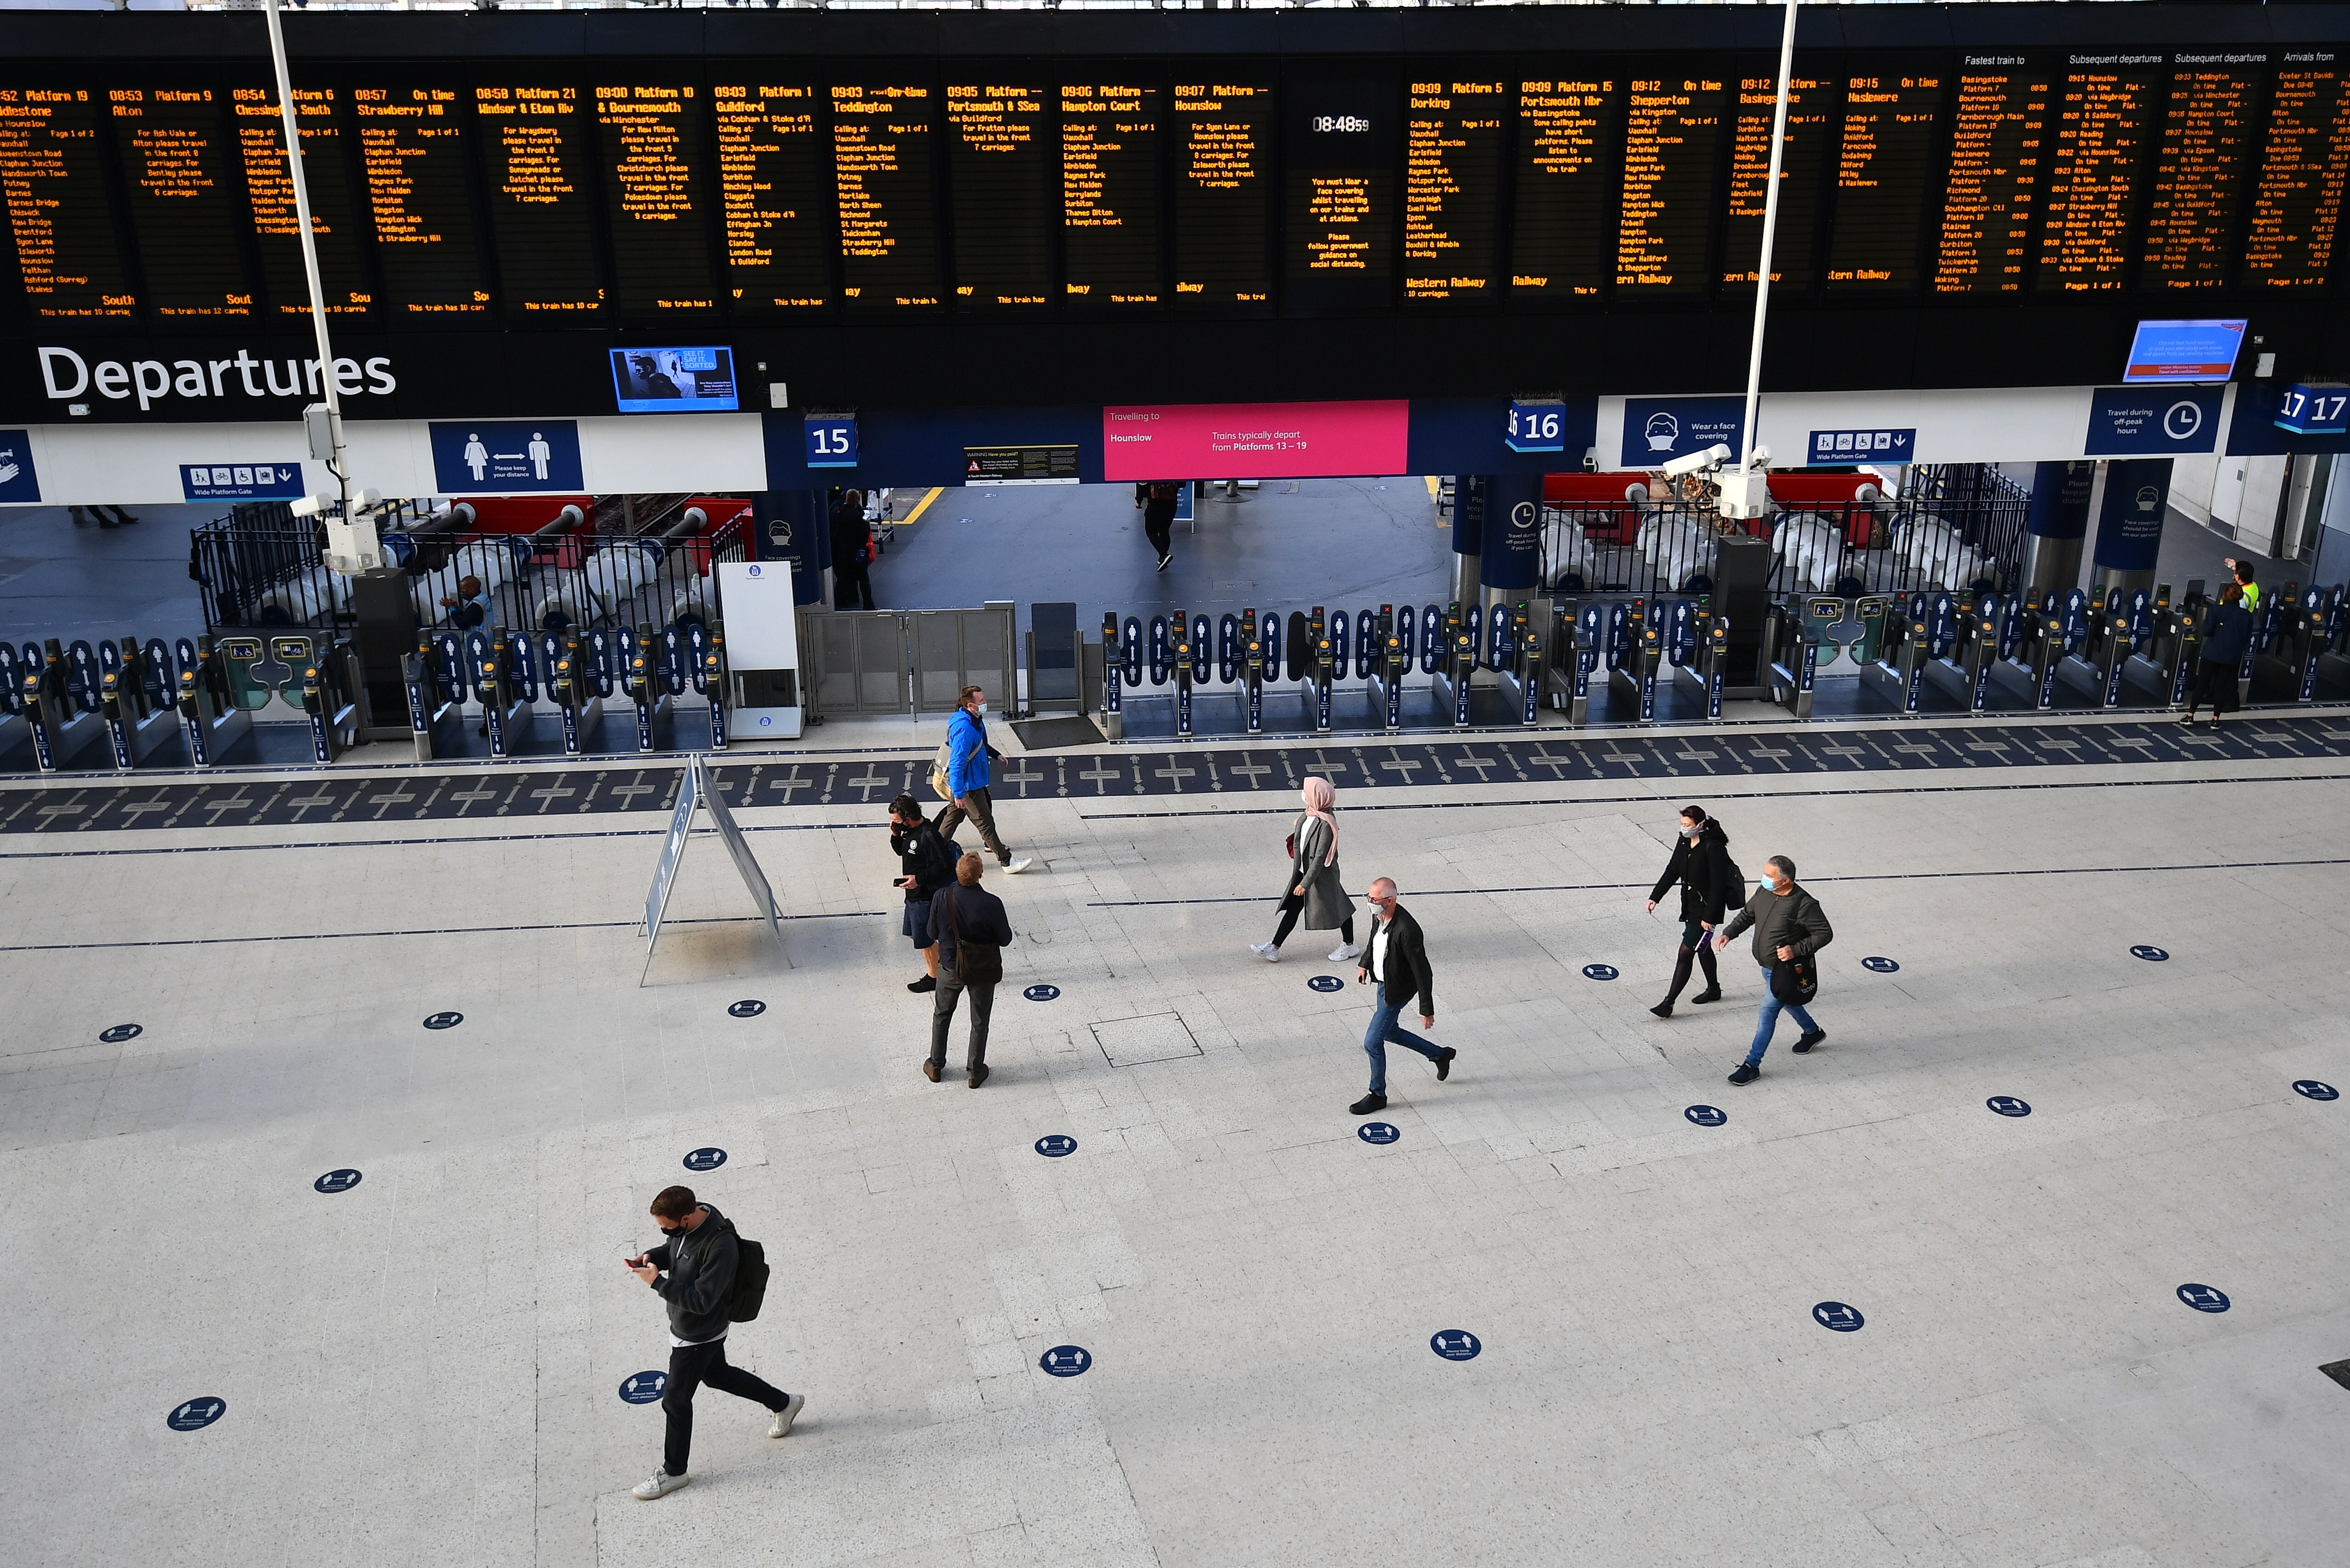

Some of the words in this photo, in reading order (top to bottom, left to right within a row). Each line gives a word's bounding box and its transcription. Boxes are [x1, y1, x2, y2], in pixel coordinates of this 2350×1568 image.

[1965, 56, 1995, 65] Fastest
[1998, 56, 2014, 64] train
[2070, 55, 2117, 65] Subsequent
[2120, 55, 2162, 64] departures
[2175, 54, 2222, 64] Subsequent
[2224, 54, 2266, 63] departures
[2316, 52, 2333, 61] from
[1412, 83, 1441, 94] 09:09
[1452, 83, 1492, 93] Platform
[1496, 83, 1502, 93] 5
[1522, 82, 1551, 92] 09:09
[1558, 82, 1597, 92] Platform
[1603, 81, 1612, 91] 15
[1632, 81, 1661, 91] 09:12
[1850, 78, 1878, 88] 09:15
[1902, 78, 1914, 87] On
[1919, 78, 1938, 87] time
[26, 90, 71, 101] Platform
[76, 90, 88, 101] 19
[109, 90, 143, 101] 08:53
[156, 90, 200, 101] Platform
[203, 90, 212, 101] 9
[233, 89, 266, 100] 08:54
[355, 90, 386, 100] 08:57
[413, 90, 427, 100] On
[431, 90, 454, 100] time
[476, 88, 509, 99] 08:58
[515, 88, 559, 99] Platform
[562, 88, 575, 98] 21
[596, 87, 627, 98] 09:00
[634, 87, 678, 97] Platform
[683, 87, 694, 97] 10
[714, 86, 746, 97] 09:03
[759, 86, 802, 97] Platform
[807, 86, 811, 96] 1
[831, 87, 862, 97] 09:03
[947, 86, 978, 97] 09:05
[986, 86, 1027, 97] Platform
[1062, 86, 1092, 96] 09:06
[1100, 86, 1141, 96] Platform
[1175, 85, 1205, 96] 09:07
[1213, 85, 1253, 96] Platform
[1521, 96, 1580, 106] Portsmouth
[1584, 95, 1603, 106] Hbr
[1631, 95, 1689, 106] Shepperton
[1848, 92, 1898, 102] Haslemere
[478, 103, 516, 114] Windsor
[520, 103, 527, 113] &
[530, 103, 554, 113] Eton
[558, 103, 573, 113] Riv
[598, 102, 605, 113] &
[609, 101, 681, 113] Bournemouth
[716, 101, 765, 112] Guildford
[833, 101, 892, 113] Teddington
[948, 101, 1004, 112] Portsmouth
[1007, 101, 1013, 111] &
[1018, 101, 1040, 111] SSea
[1062, 101, 1106, 112] Hampton
[1110, 101, 1141, 111] Court
[1175, 100, 1221, 110] Hounslow
[1411, 98, 1450, 109] Dorking
[113, 106, 142, 116] Alton
[358, 105, 423, 117] Strawberry
[427, 104, 443, 115] Hill
[1063, 144, 1090, 152] Clapham
[1335, 187, 1364, 196] covering
[377, 225, 416, 234] Teddington
[1407, 278, 1447, 287] Western
[1451, 277, 1485, 288] Railway
[39, 347, 396, 411] Departures
[2281, 392, 2305, 417] 17
[2311, 397, 2346, 421] 17
[1110, 412, 1148, 422] Travelling
[2130, 409, 2153, 417] during
[1509, 409, 1518, 436] 16
[1526, 413, 1558, 439] 16
[1719, 422, 1735, 430] face
[813, 429, 849, 454] 15
[1110, 433, 1152, 442] Hounslow
[1212, 432, 1236, 440] Trains
[1238, 431, 1271, 441] typically
[1274, 431, 1300, 440] depart
[1695, 432, 1728, 442] covering
[1212, 443, 1231, 451] from
[1234, 442, 1274, 451] Platforms
[1276, 442, 1286, 450] 13
[1296, 442, 1307, 450] 19
